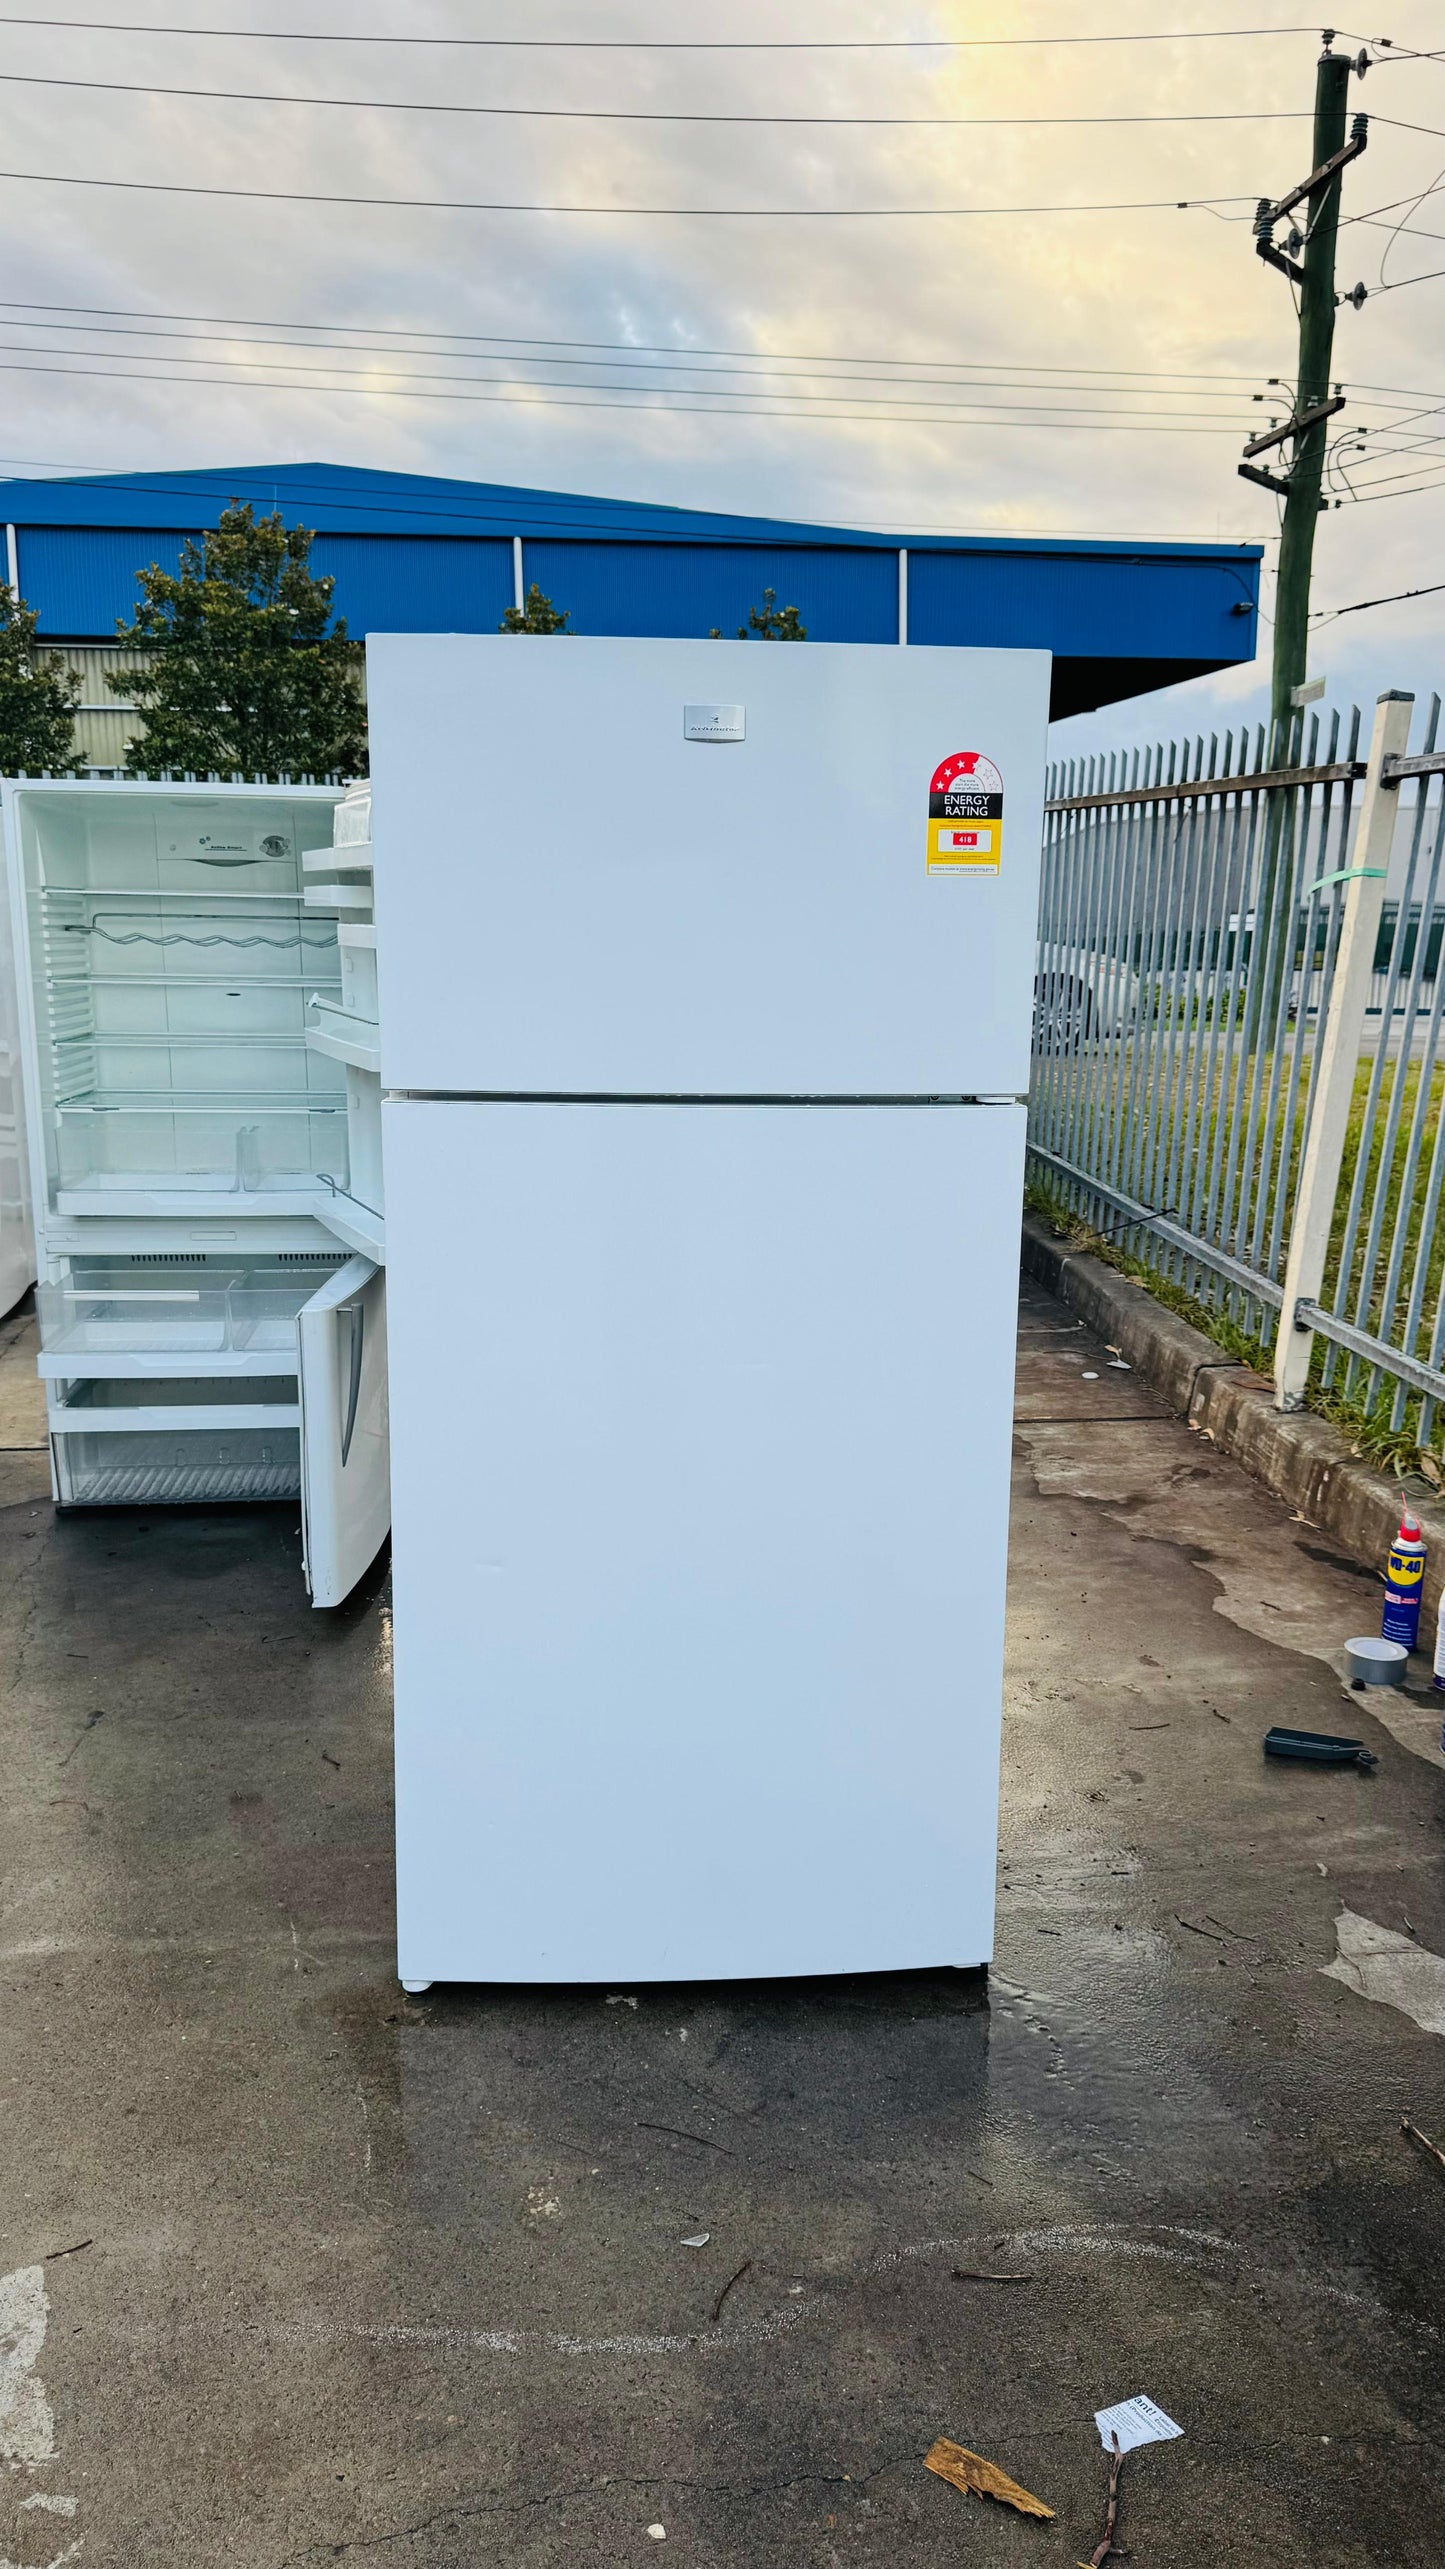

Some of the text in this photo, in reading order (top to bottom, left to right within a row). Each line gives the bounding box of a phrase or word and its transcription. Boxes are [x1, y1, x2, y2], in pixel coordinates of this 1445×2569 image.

[944, 795, 990, 805] ENERGY
[945, 806, 988, 816] RATING
[958, 836, 973, 844] 418
